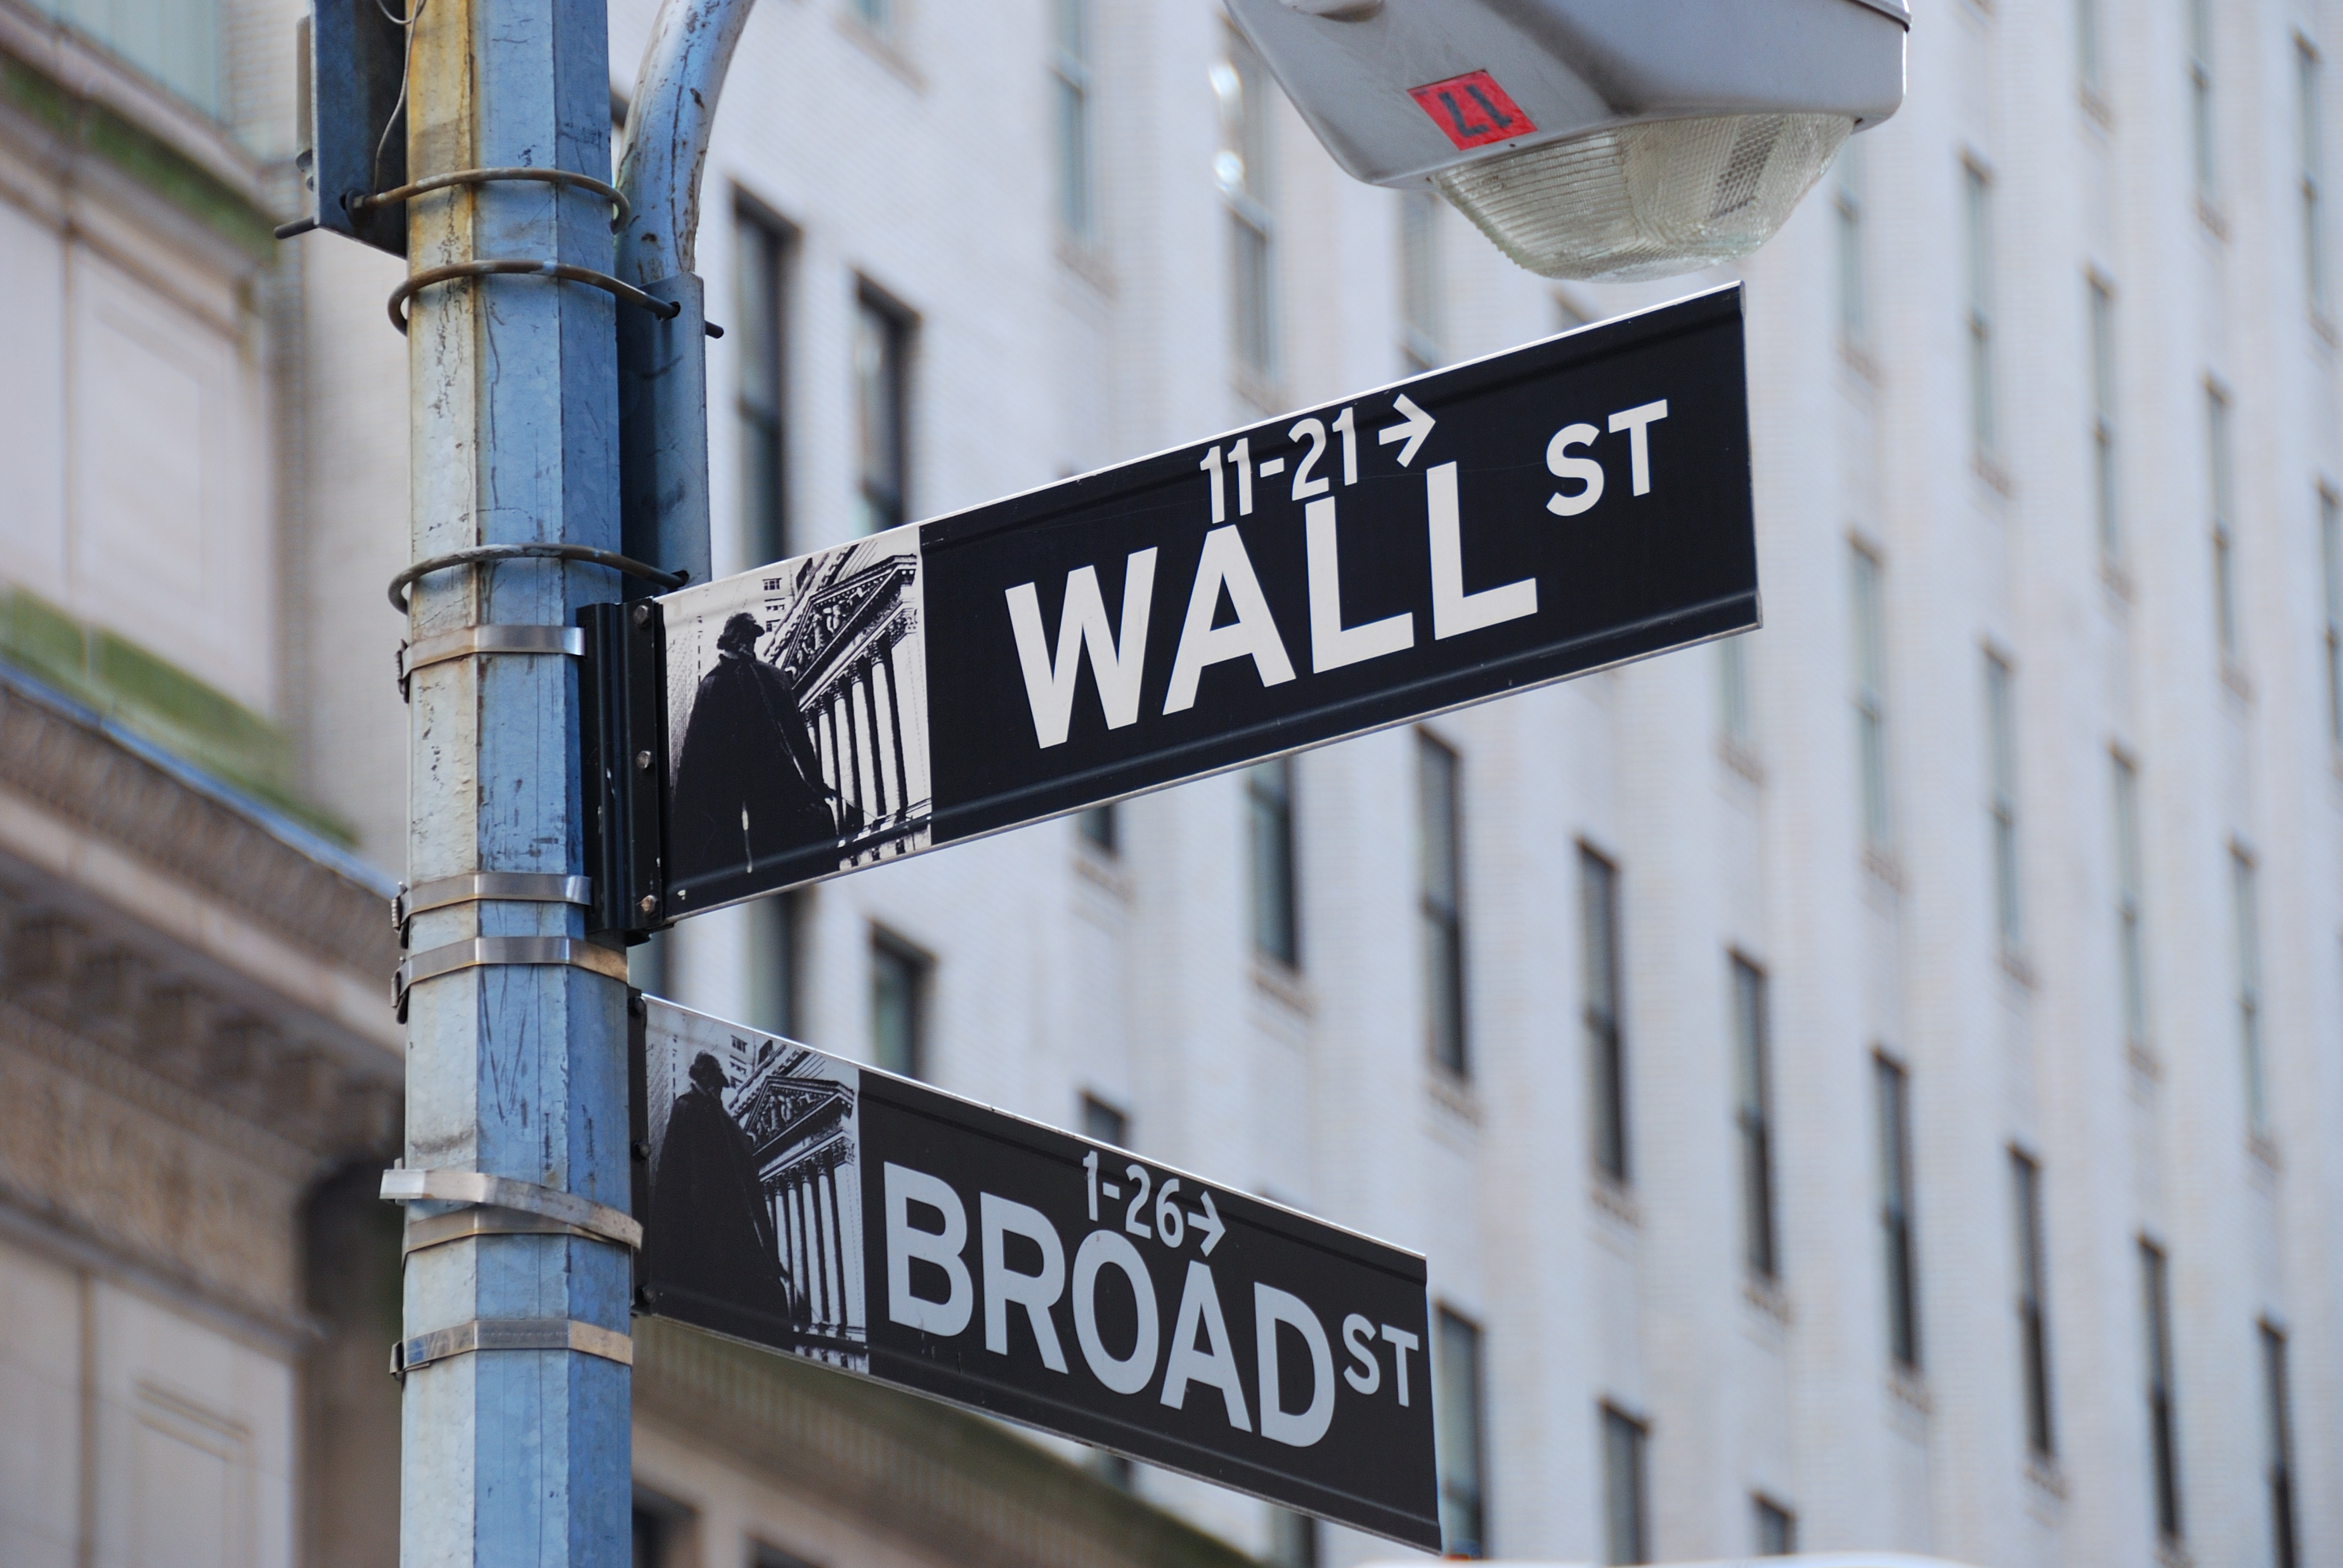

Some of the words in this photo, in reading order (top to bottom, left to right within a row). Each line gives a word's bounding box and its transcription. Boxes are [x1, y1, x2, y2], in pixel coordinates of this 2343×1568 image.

[1438, 84, 1513, 138] 17
[1200, 406, 1357, 524] 11-21
[1005, 461, 1538, 749] WALL
[1546, 399, 1668, 517] ST
[1082, 1150, 1184, 1248] 1-26
[884, 1161, 1335, 1448] BROAD
[1342, 1312, 1419, 1407] ST
